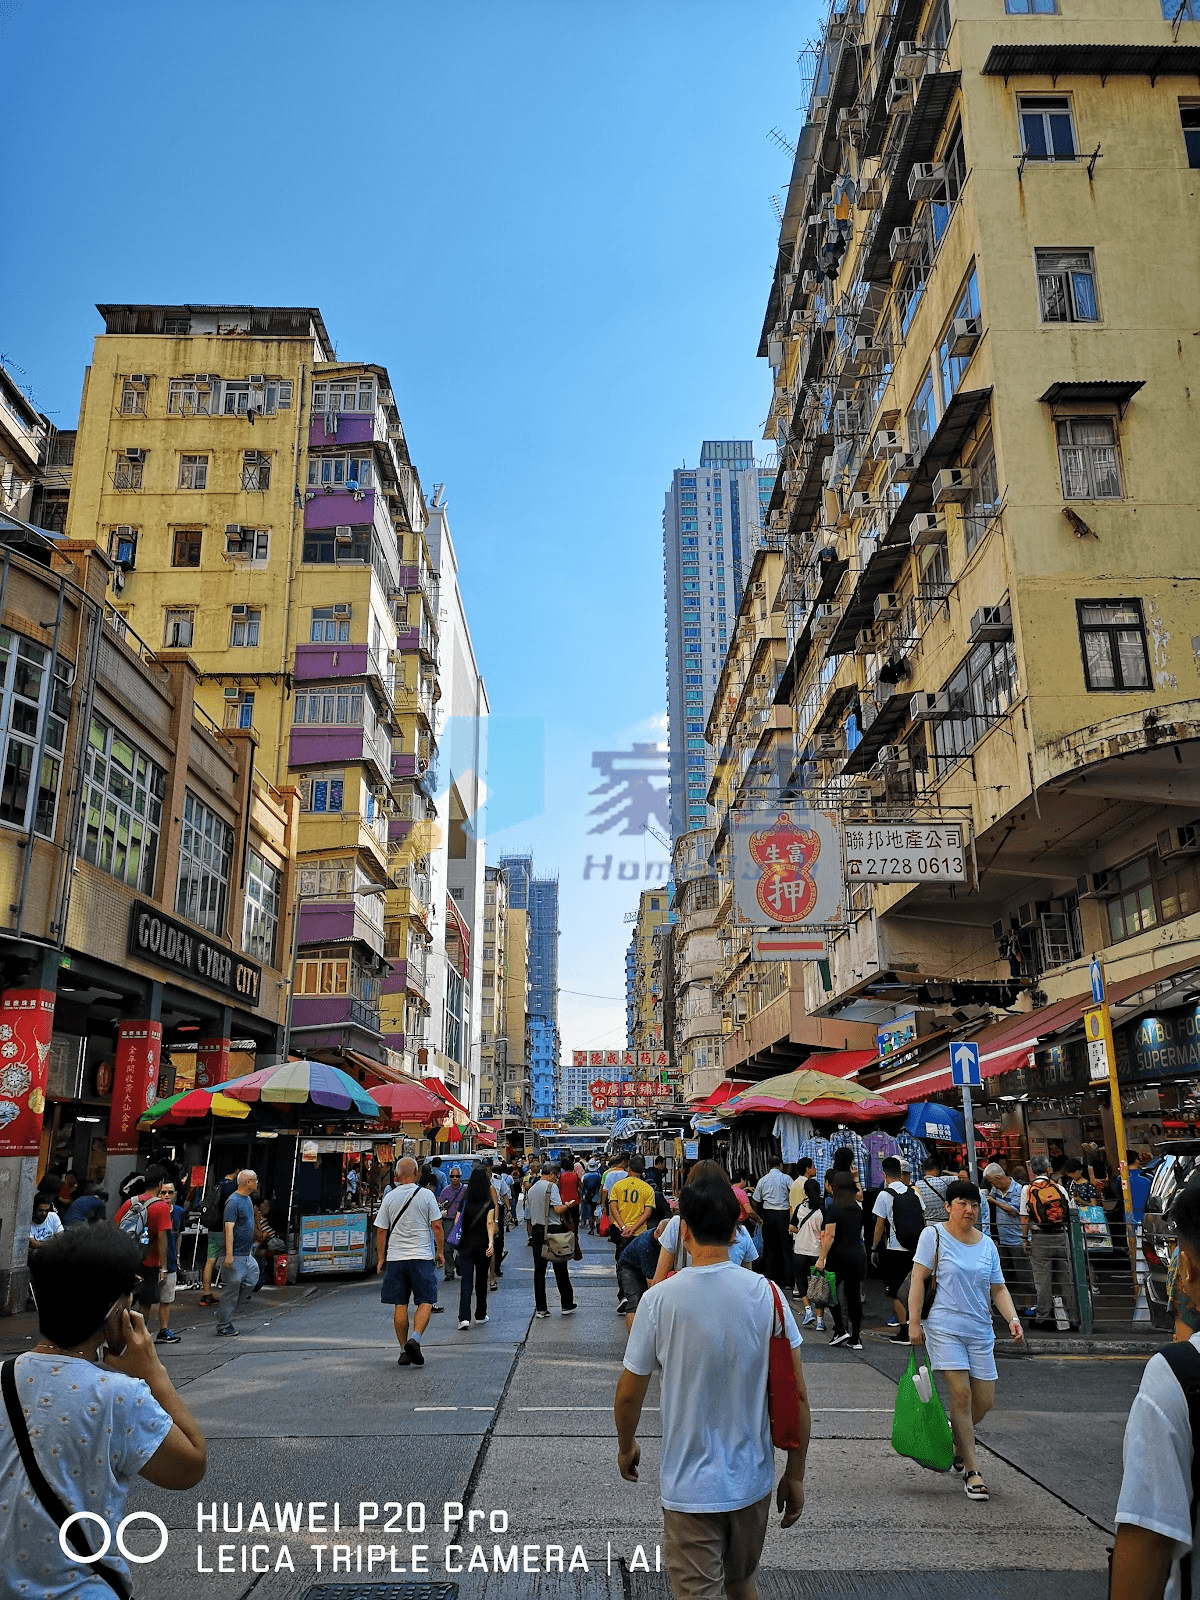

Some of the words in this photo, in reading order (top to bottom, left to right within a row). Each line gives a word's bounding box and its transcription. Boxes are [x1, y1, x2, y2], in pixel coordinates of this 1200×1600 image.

[845, 829, 962, 850] 聯邦地產公司
[866, 857, 912, 875] 2728
[918, 857, 963, 875] 0613
[766, 874, 807, 913] 押
[138, 913, 193, 968] GOLDEN
[197, 942, 232, 987] CYBER
[235, 963, 259, 998] CITY
[1135, 1025, 1153, 1047] KAI
[1154, 1021, 1173, 1043] BO
[1137, 1042, 1200, 1070] SUPERMA
[623, 1188, 639, 1204] 10
